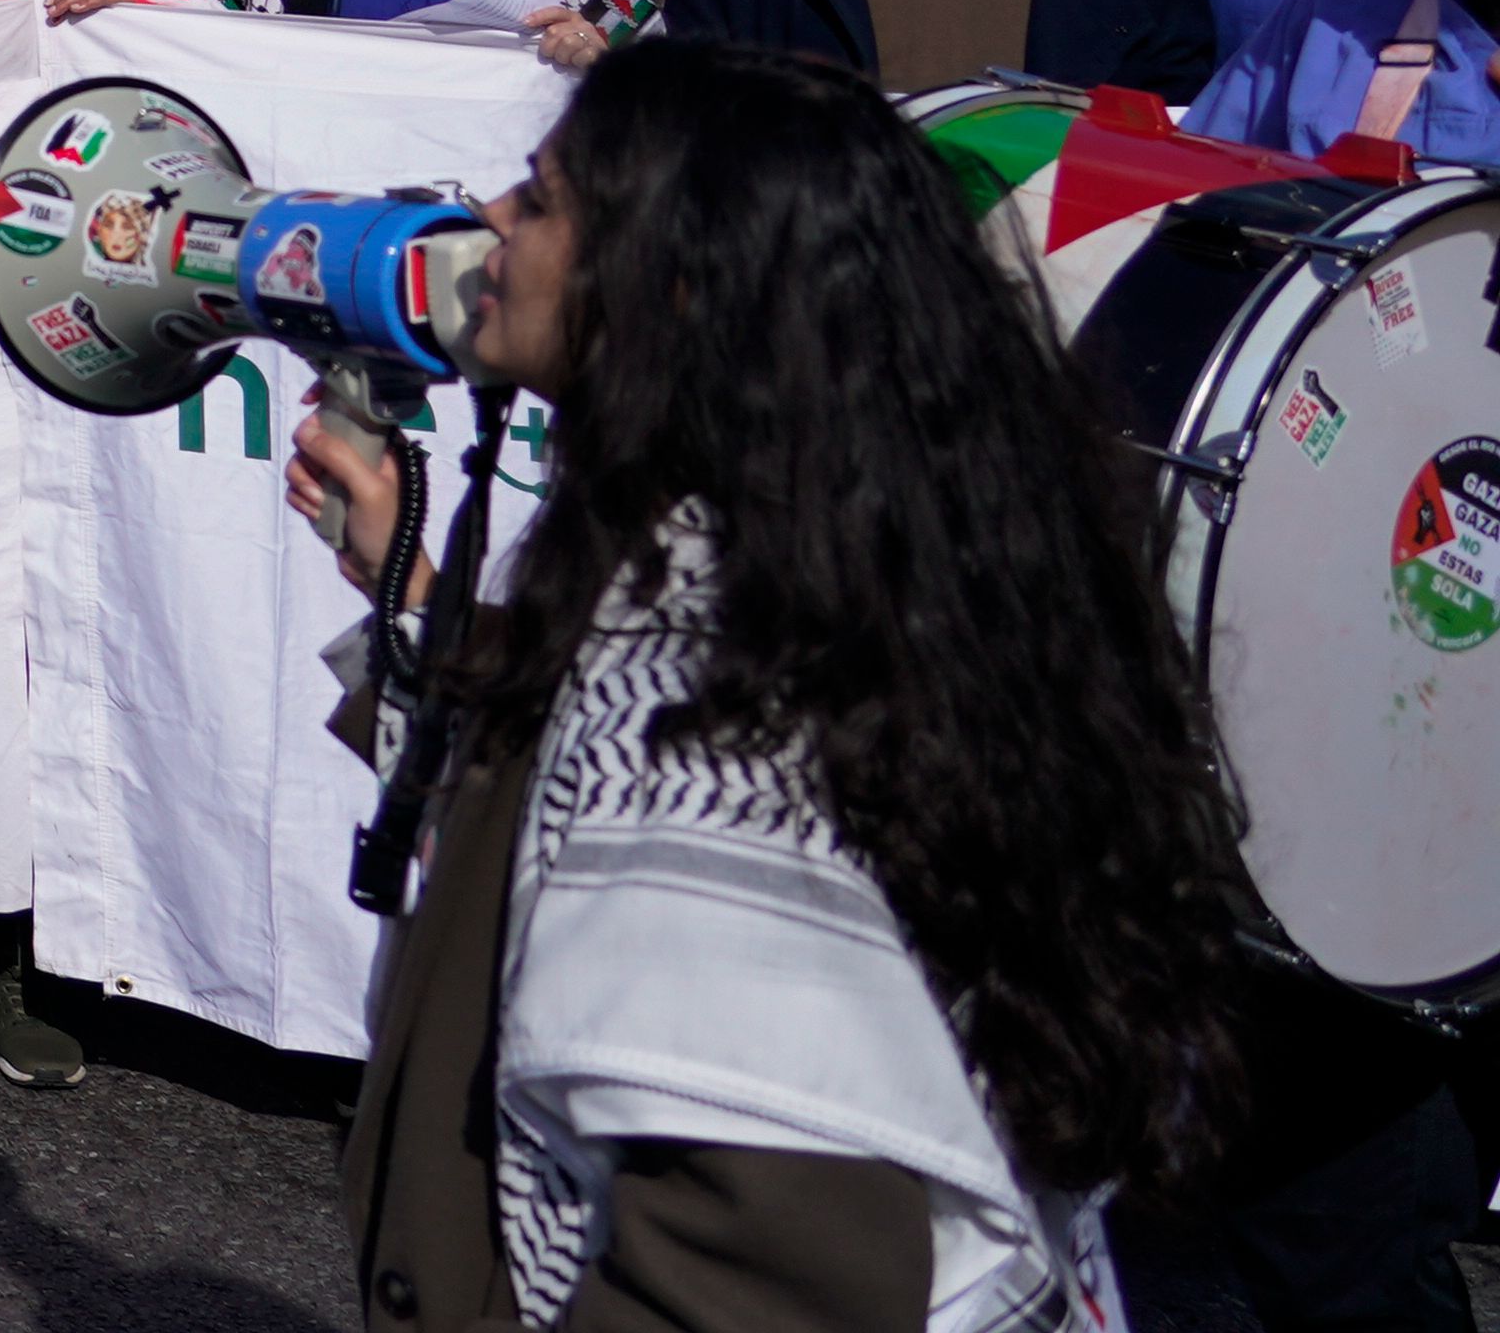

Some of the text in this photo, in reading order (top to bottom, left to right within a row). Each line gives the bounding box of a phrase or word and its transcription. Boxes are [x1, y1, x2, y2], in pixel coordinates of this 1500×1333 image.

[1462, 472, 1500, 512] GAZ
[1458, 535, 1482, 557] NO
[1438, 550, 1484, 586] ESTAS
[1430, 574, 1474, 611] SOLA
